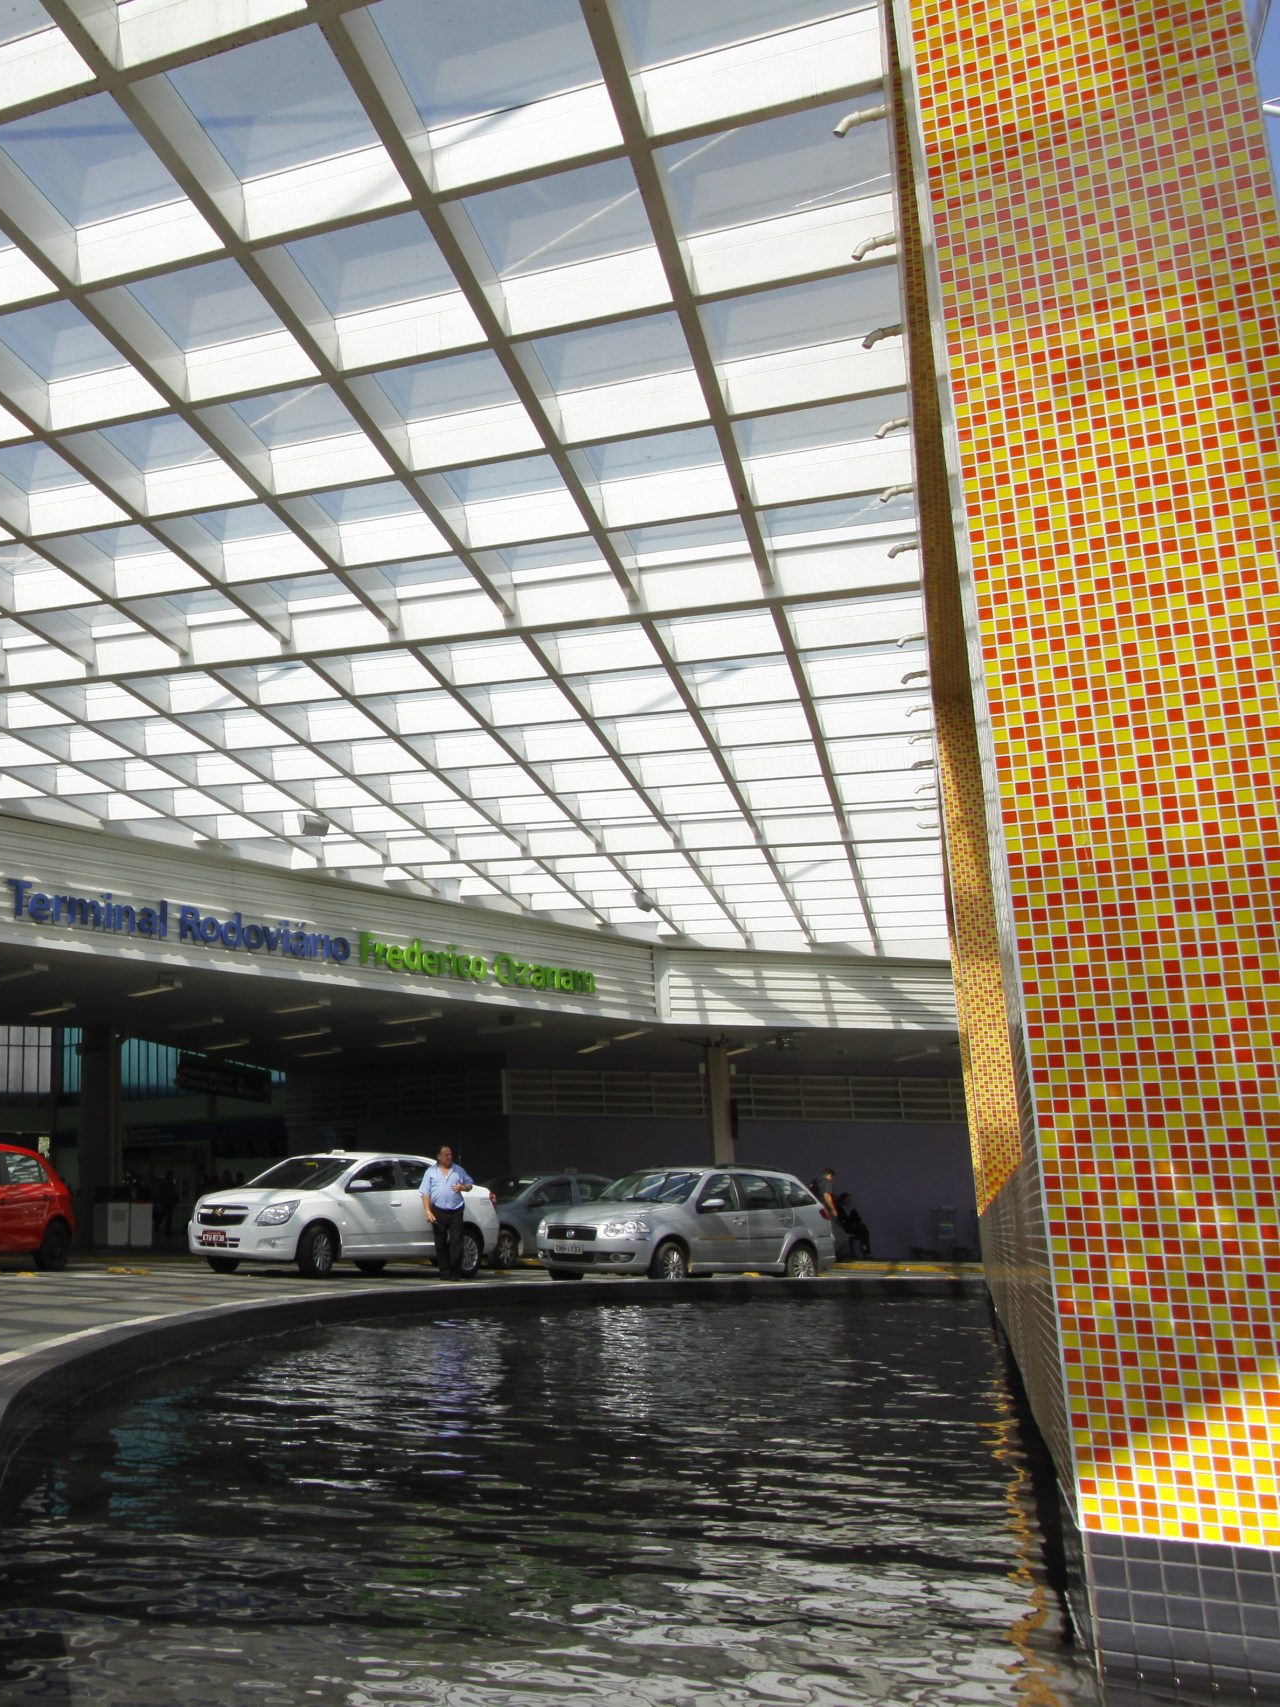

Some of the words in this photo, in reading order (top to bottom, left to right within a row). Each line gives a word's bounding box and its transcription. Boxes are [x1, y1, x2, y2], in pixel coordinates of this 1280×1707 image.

[5, 879, 168, 937] Terminal
[179, 905, 352, 961] Rodoviário
[360, 931, 487, 981] Frederico
[493, 953, 597, 993] Ozanam
